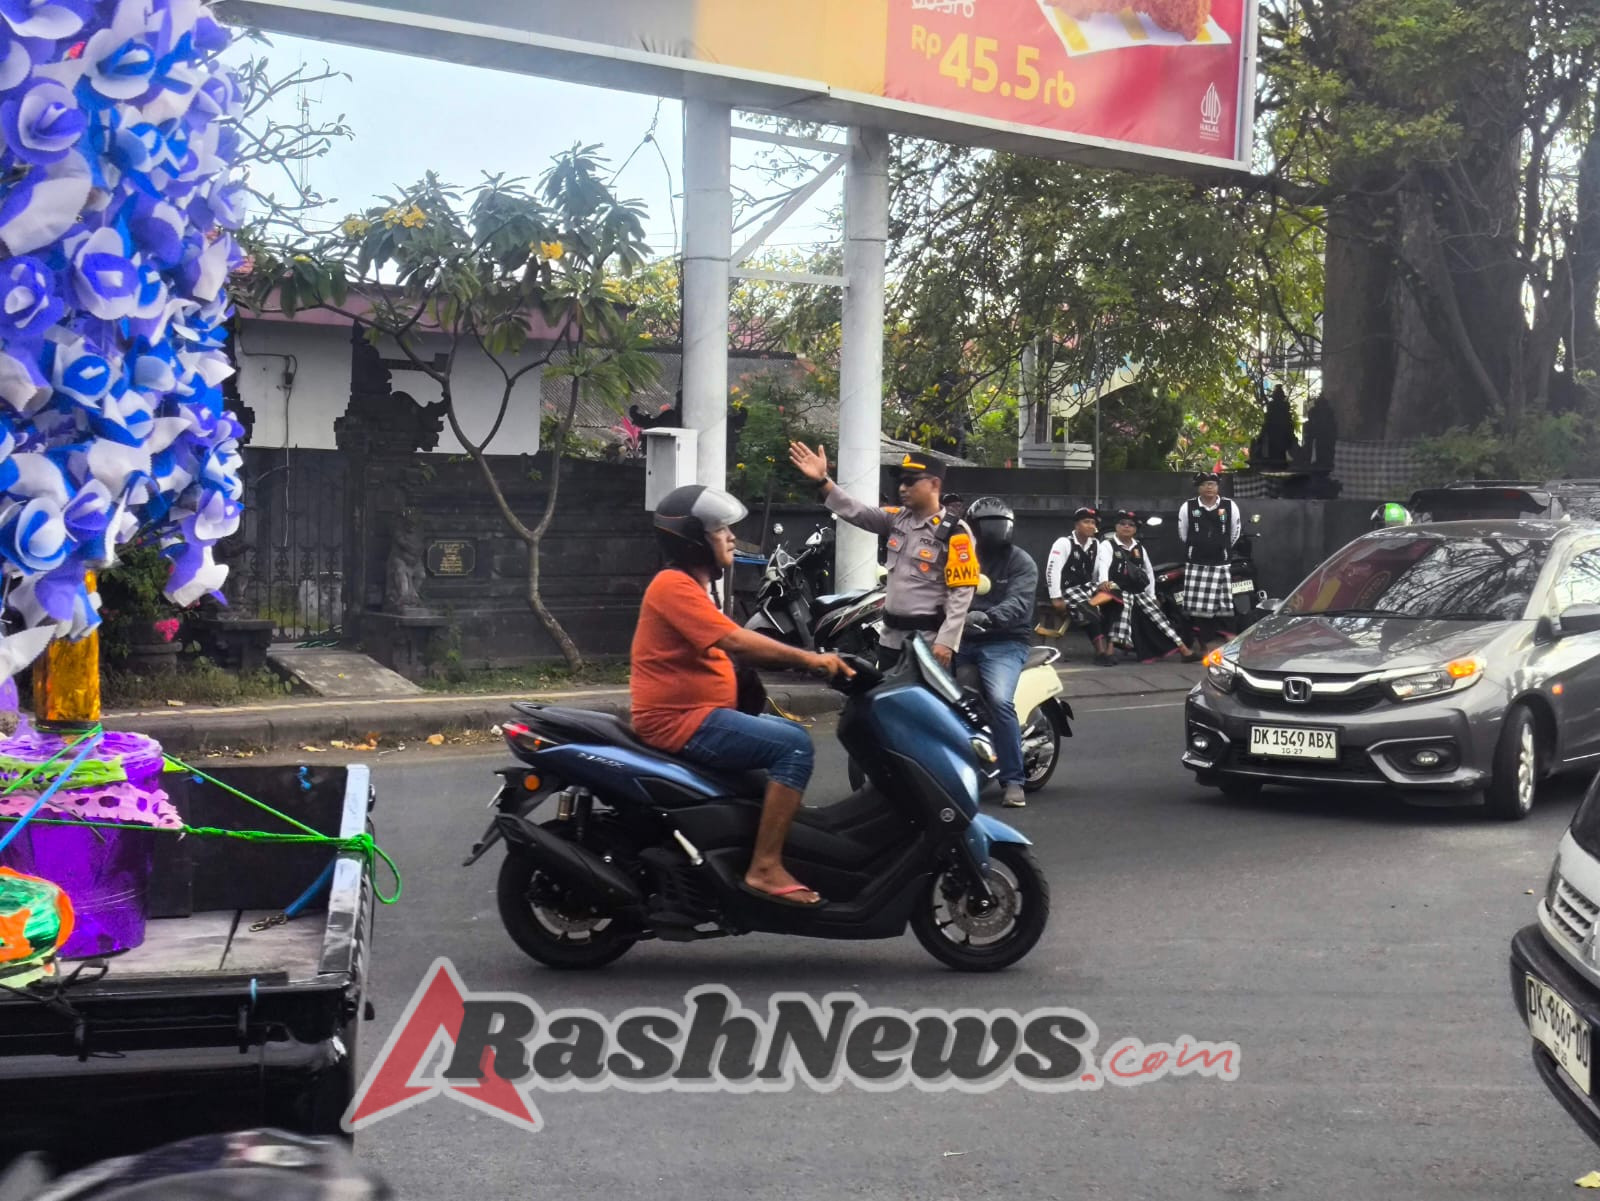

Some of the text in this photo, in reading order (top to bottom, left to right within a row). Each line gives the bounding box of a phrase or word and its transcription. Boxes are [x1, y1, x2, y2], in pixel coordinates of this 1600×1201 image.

[1253, 728, 1334, 749] DK 1549 ABX
[1527, 978, 1547, 1023] DK
